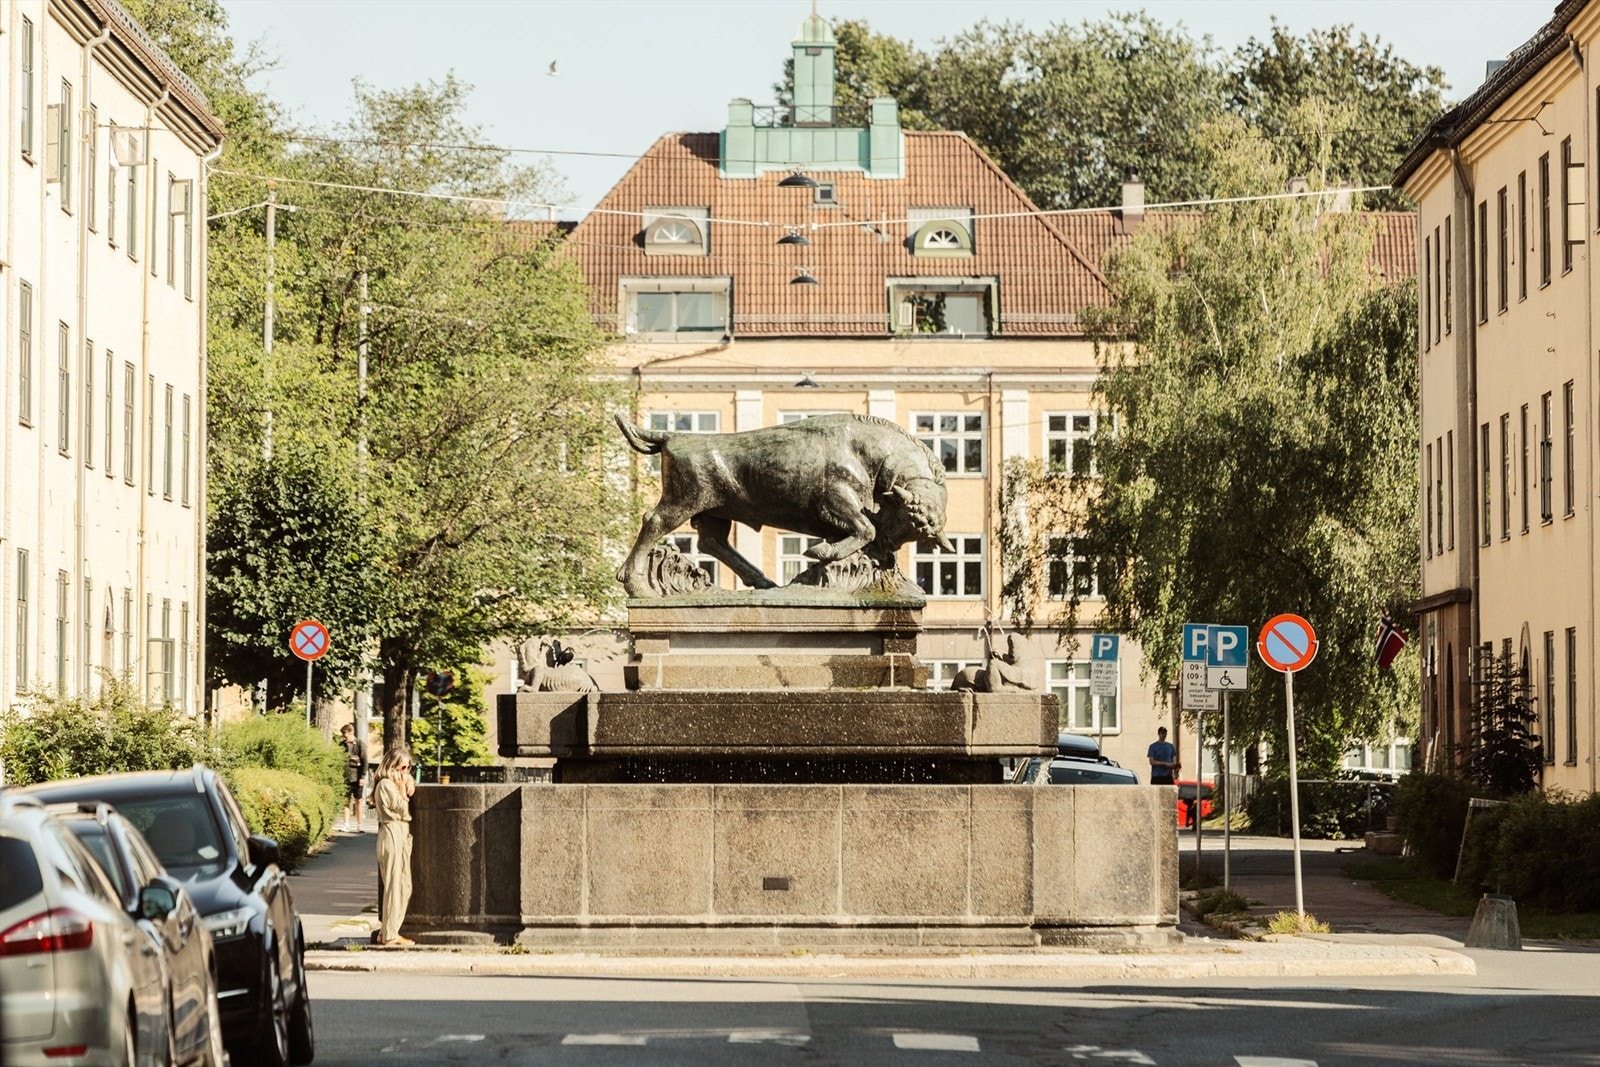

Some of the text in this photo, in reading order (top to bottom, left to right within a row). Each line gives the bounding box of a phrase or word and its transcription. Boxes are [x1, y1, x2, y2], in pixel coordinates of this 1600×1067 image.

[1098, 637, 1113, 657] P
[1191, 628, 1207, 656] P
[1217, 631, 1238, 661] P
